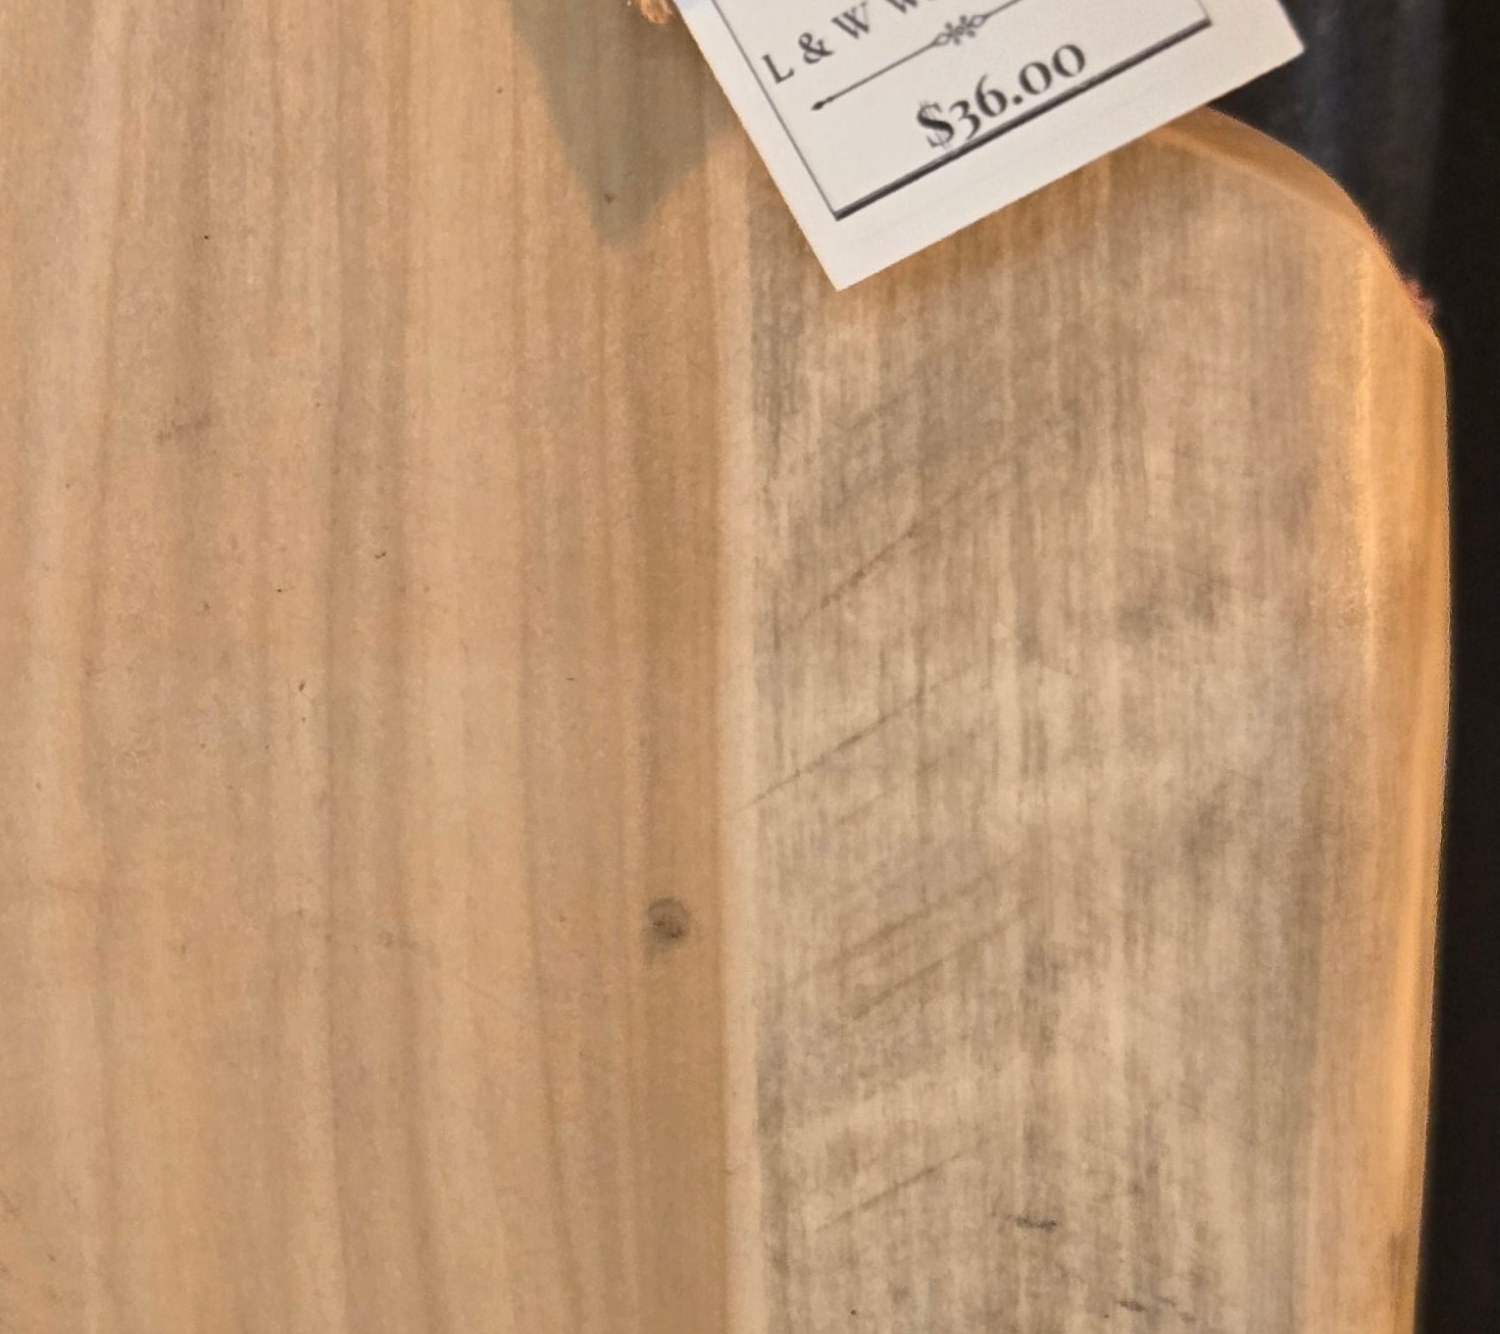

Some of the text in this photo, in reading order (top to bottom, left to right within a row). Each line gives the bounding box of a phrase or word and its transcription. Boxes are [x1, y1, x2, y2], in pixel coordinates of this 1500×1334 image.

[761, 52, 795, 85] L
[798, 31, 834, 65] &
[831, 1, 871, 41] W
[915, 42, 1087, 150] $36.00
